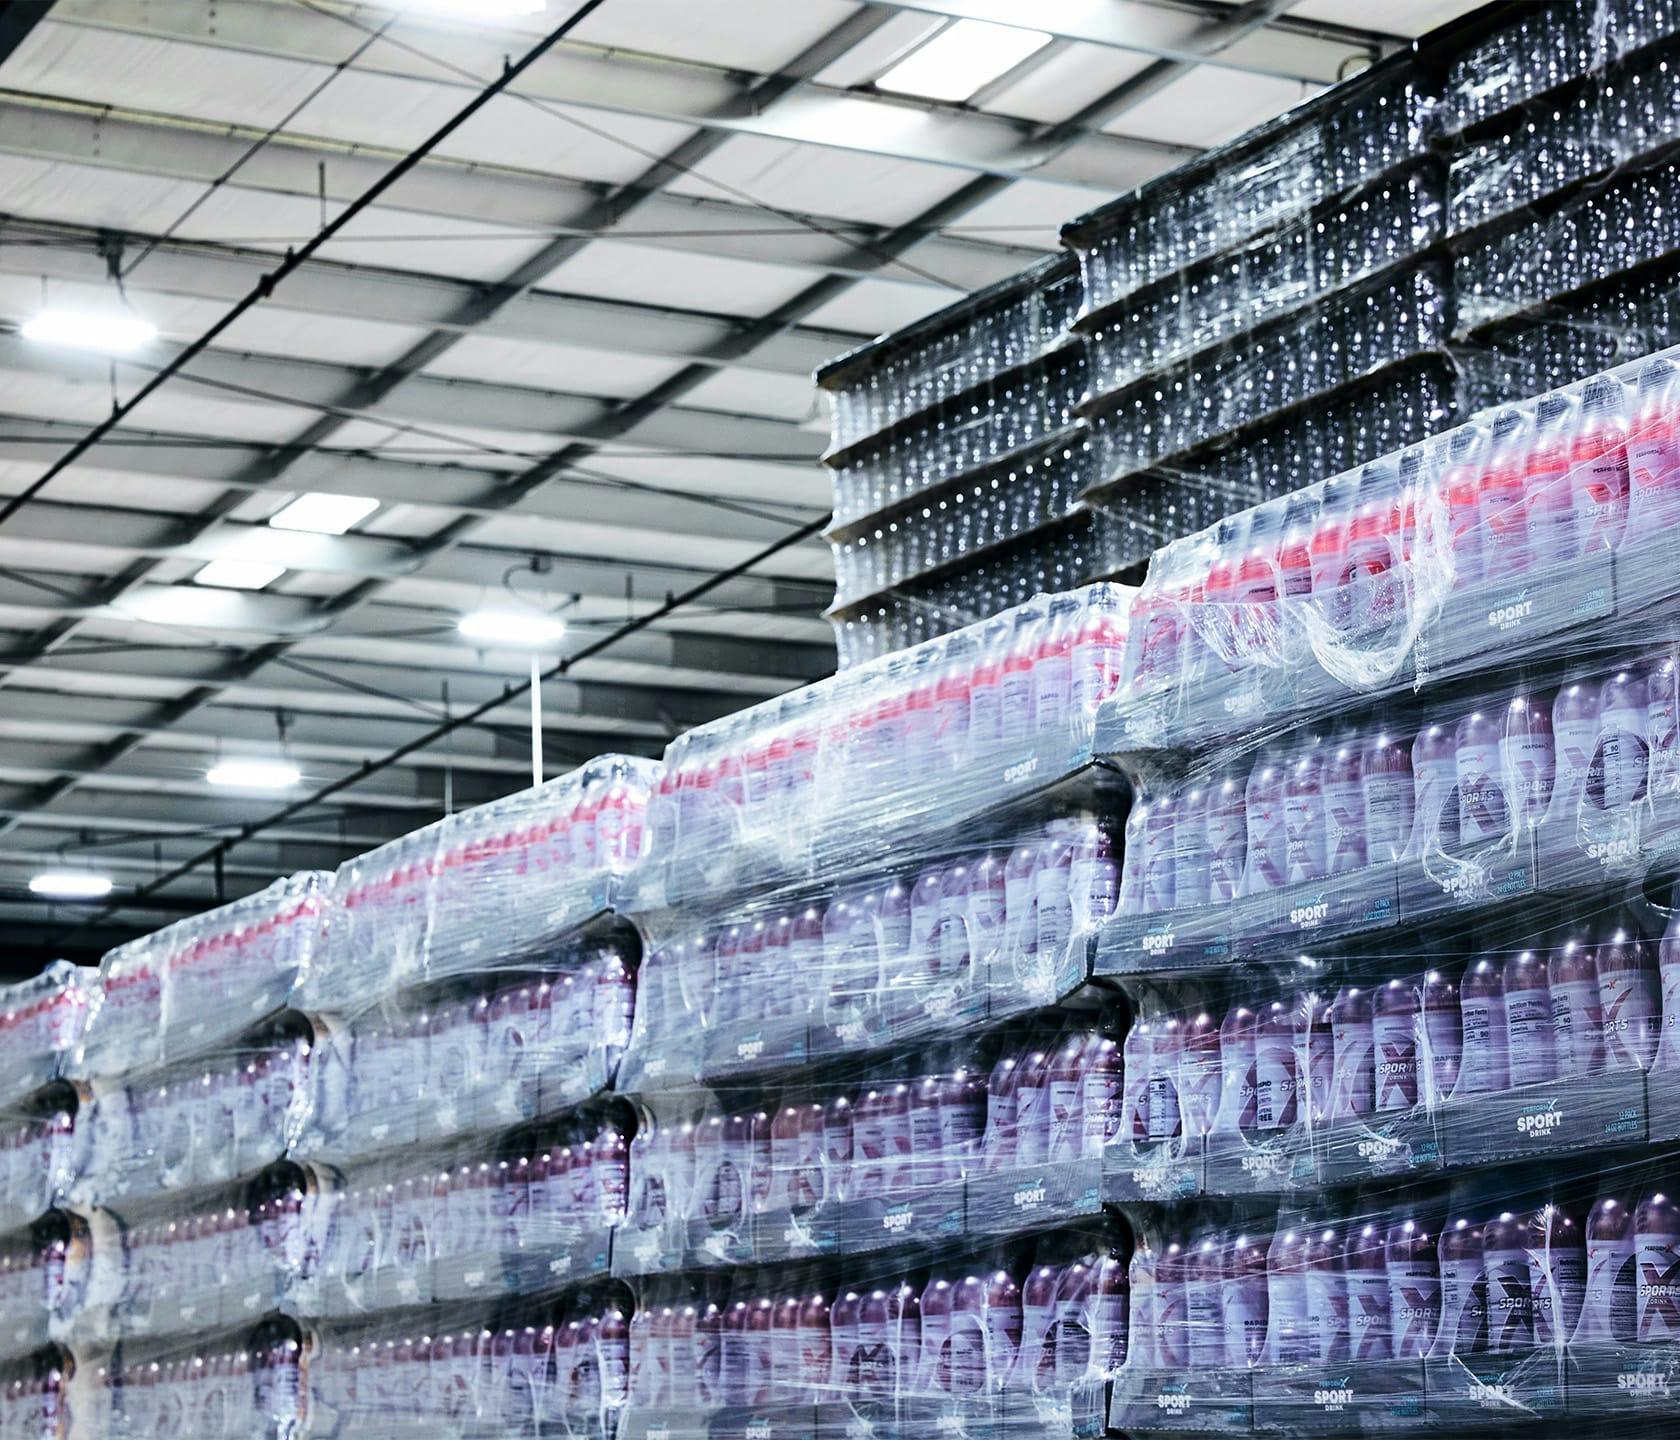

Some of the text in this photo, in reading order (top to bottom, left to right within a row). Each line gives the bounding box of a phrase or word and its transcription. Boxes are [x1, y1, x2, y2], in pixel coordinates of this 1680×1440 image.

[1488, 600, 1533, 626] SPORT
[1442, 869, 1485, 893] SPORT
[1290, 903, 1329, 924] SPORT
[1142, 934, 1175, 951] SPORT
[1516, 1111, 1562, 1132] SPORT
[1529, 1127, 1552, 1137] DRINK
[1241, 1155, 1276, 1171] SPORT
[1013, 1188, 1046, 1206] SPORT
[883, 1212, 914, 1229] SPORT
[1616, 1373, 1667, 1390] SPORT
[1157, 1394, 1192, 1409] SPORT
[1314, 1389, 1354, 1405] SPORT
[1325, 1404, 1344, 1412] DRINK
